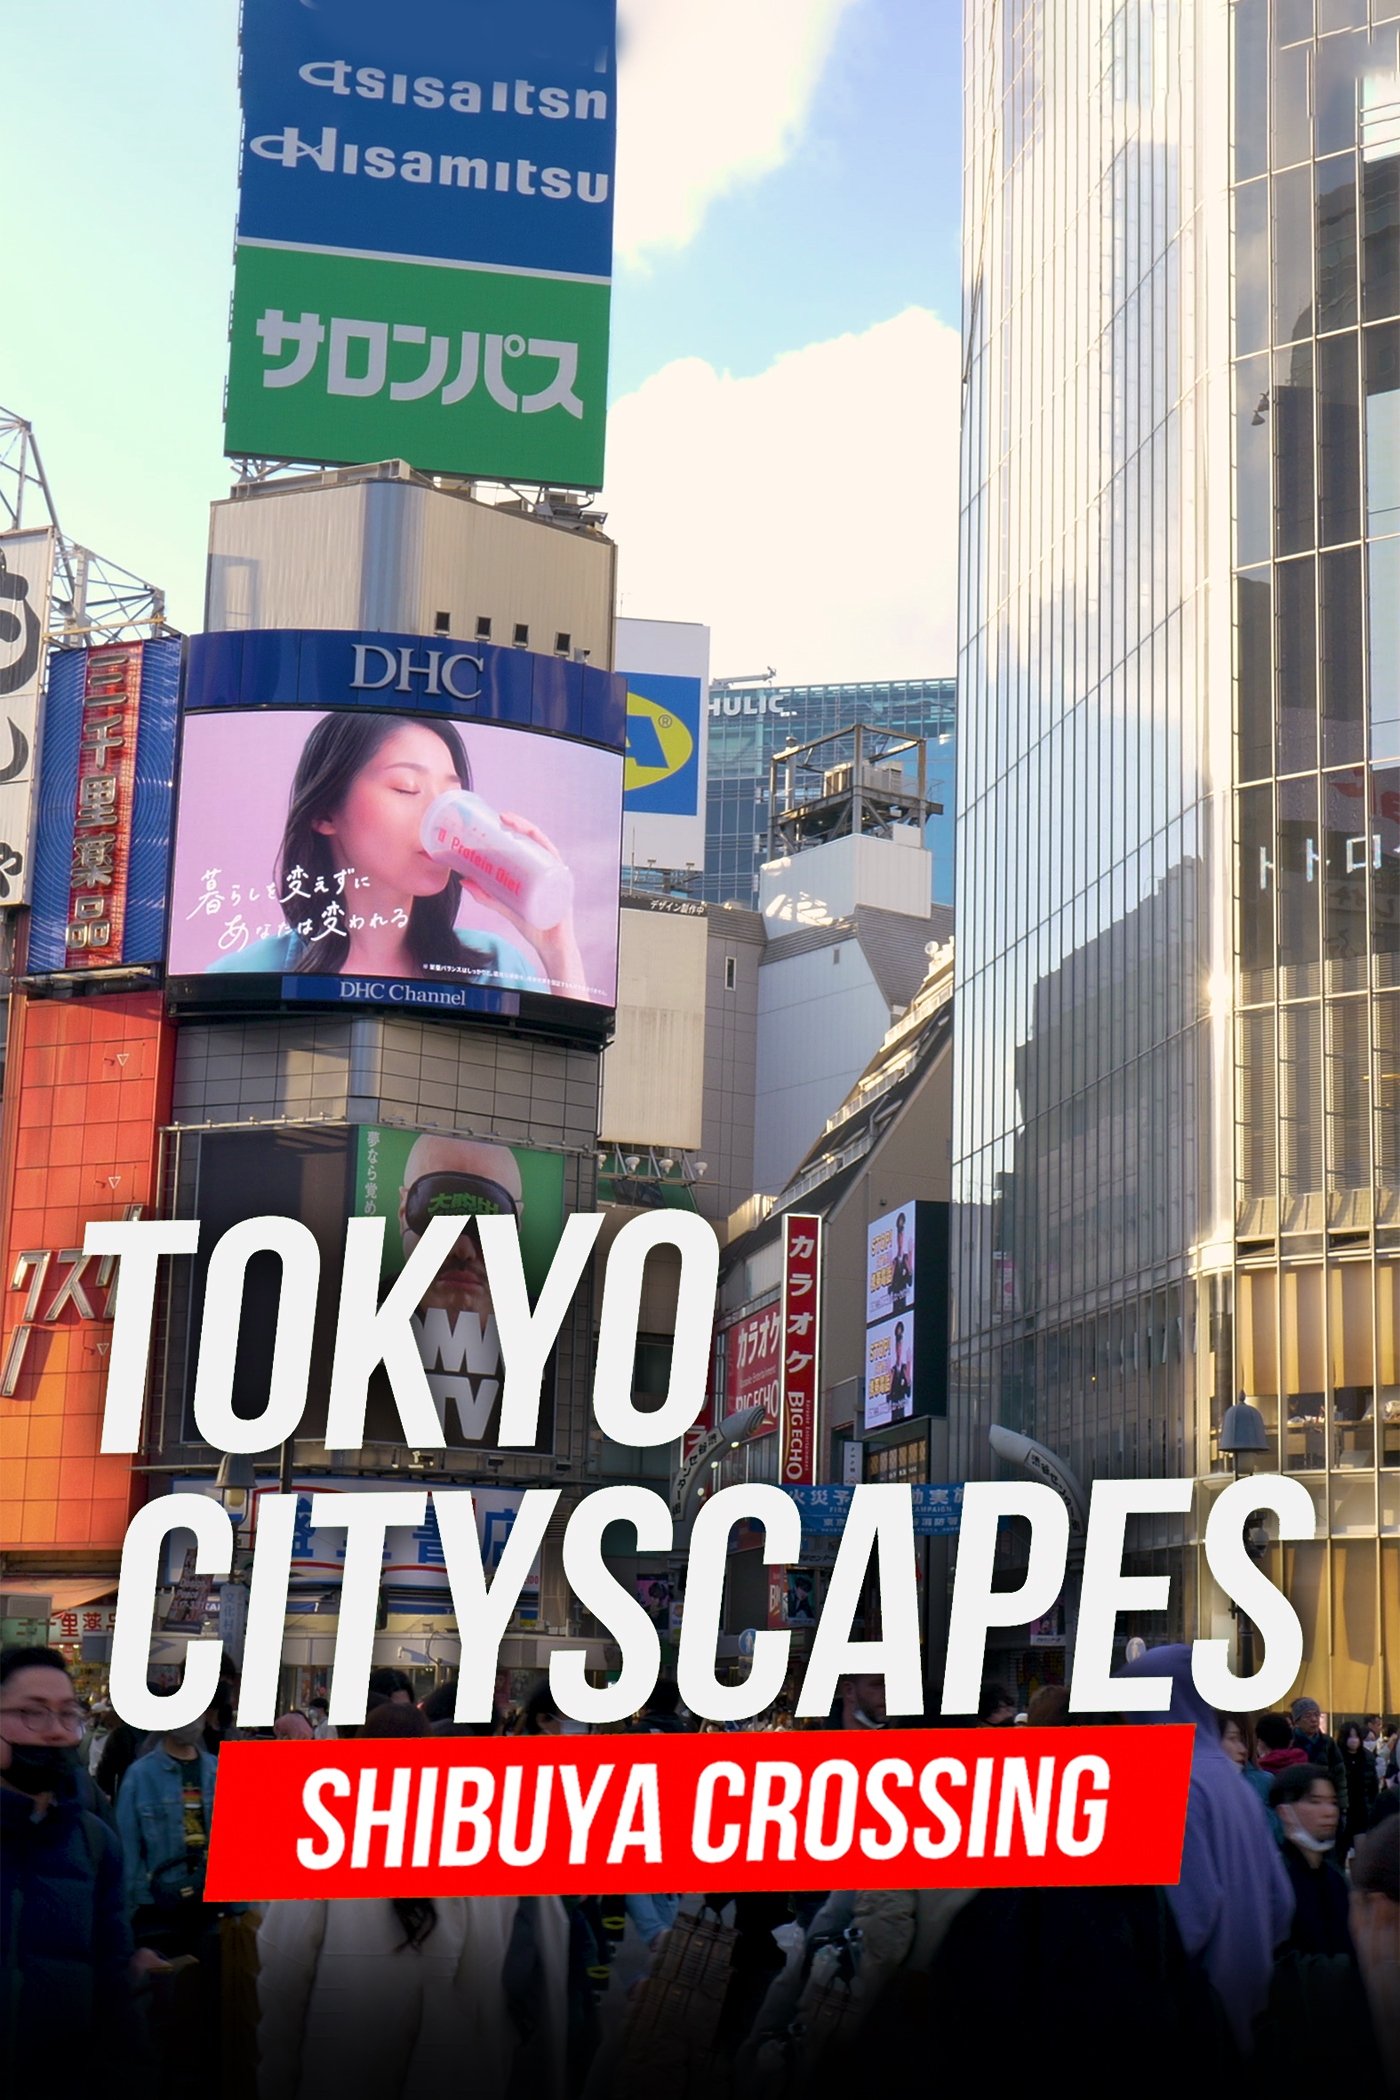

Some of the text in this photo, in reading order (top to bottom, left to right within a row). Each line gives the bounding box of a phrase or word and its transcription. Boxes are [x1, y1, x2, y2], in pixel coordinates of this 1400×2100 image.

[250, 127, 609, 203] Hisamitsu
[256, 308, 584, 420] サロンパス
[349, 643, 485, 700] DHC
[65, 653, 131, 949] 三千里薬品
[451, 836, 493, 875] Protein
[186, 865, 371, 921] 暮らしを変えずに
[650, 899, 705, 915] デザイン製作中
[218, 900, 409, 952] あなたは変われる
[340, 980, 467, 1007] DHC Channel
[785, 1234, 814, 1374] カラオケ
[737, 1311, 781, 1369] カラオケ
[786, 1391, 805, 1480] BIG ECHO
